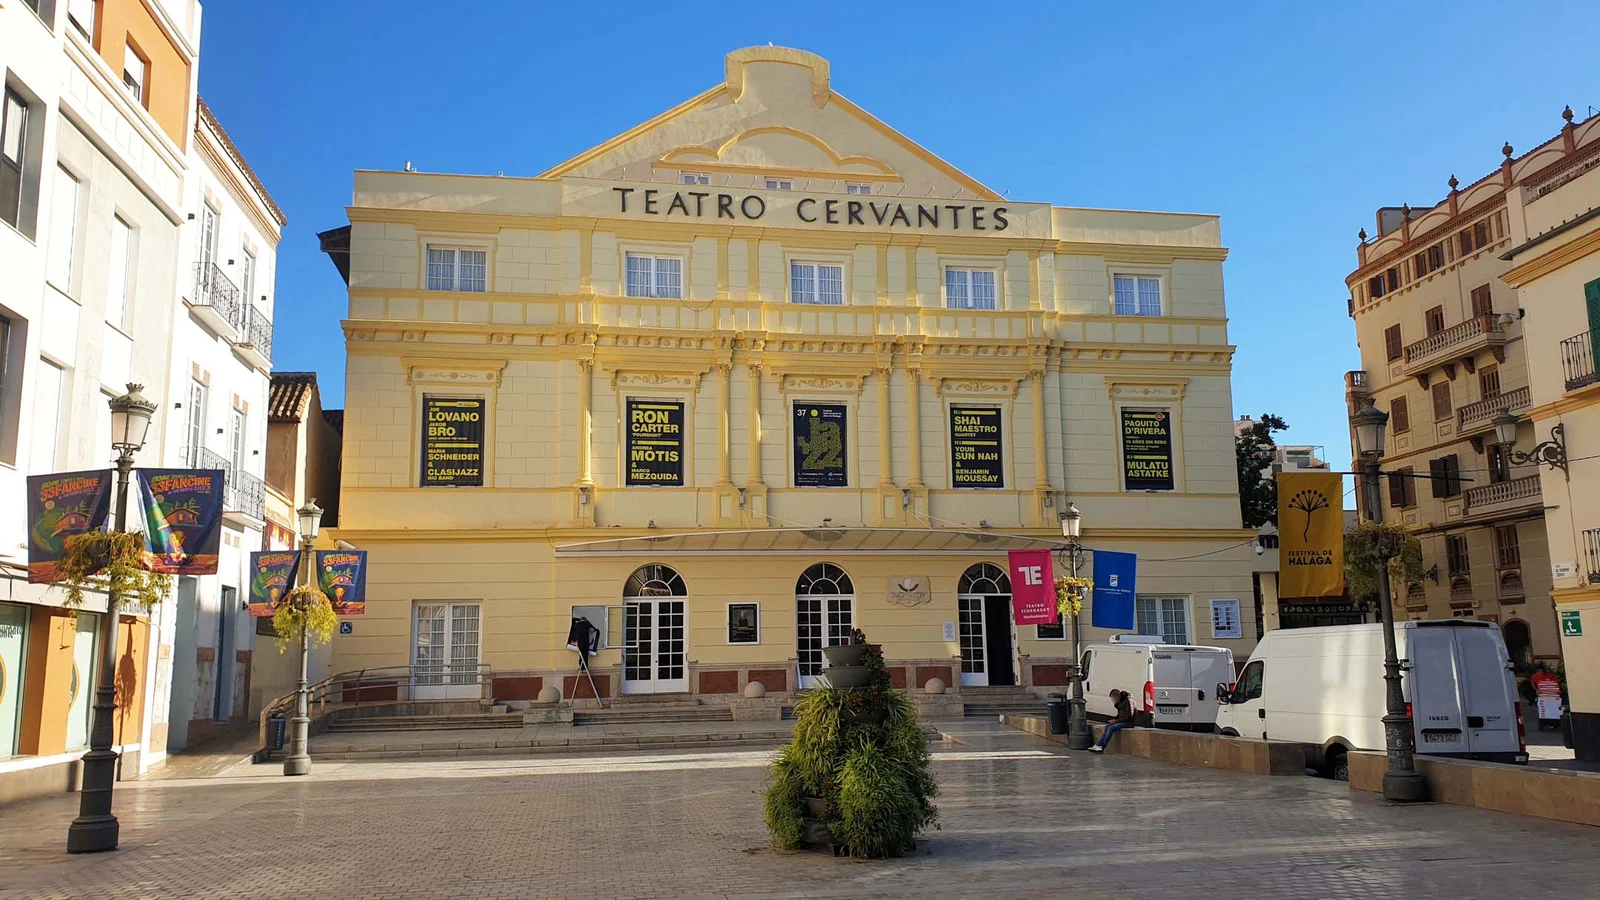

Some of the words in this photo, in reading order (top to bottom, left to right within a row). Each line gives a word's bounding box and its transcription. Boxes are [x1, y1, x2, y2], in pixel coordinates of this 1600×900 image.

[612, 187, 765, 220] TEATRO
[796, 198, 1009, 231] CERVANTES
[428, 412, 480, 422] LOVANO
[632, 410, 669, 424] RON
[954, 416, 980, 425] SHAI
[428, 427, 456, 436] BRO
[632, 423, 679, 433] CARTER
[632, 450, 679, 462] MOTIS
